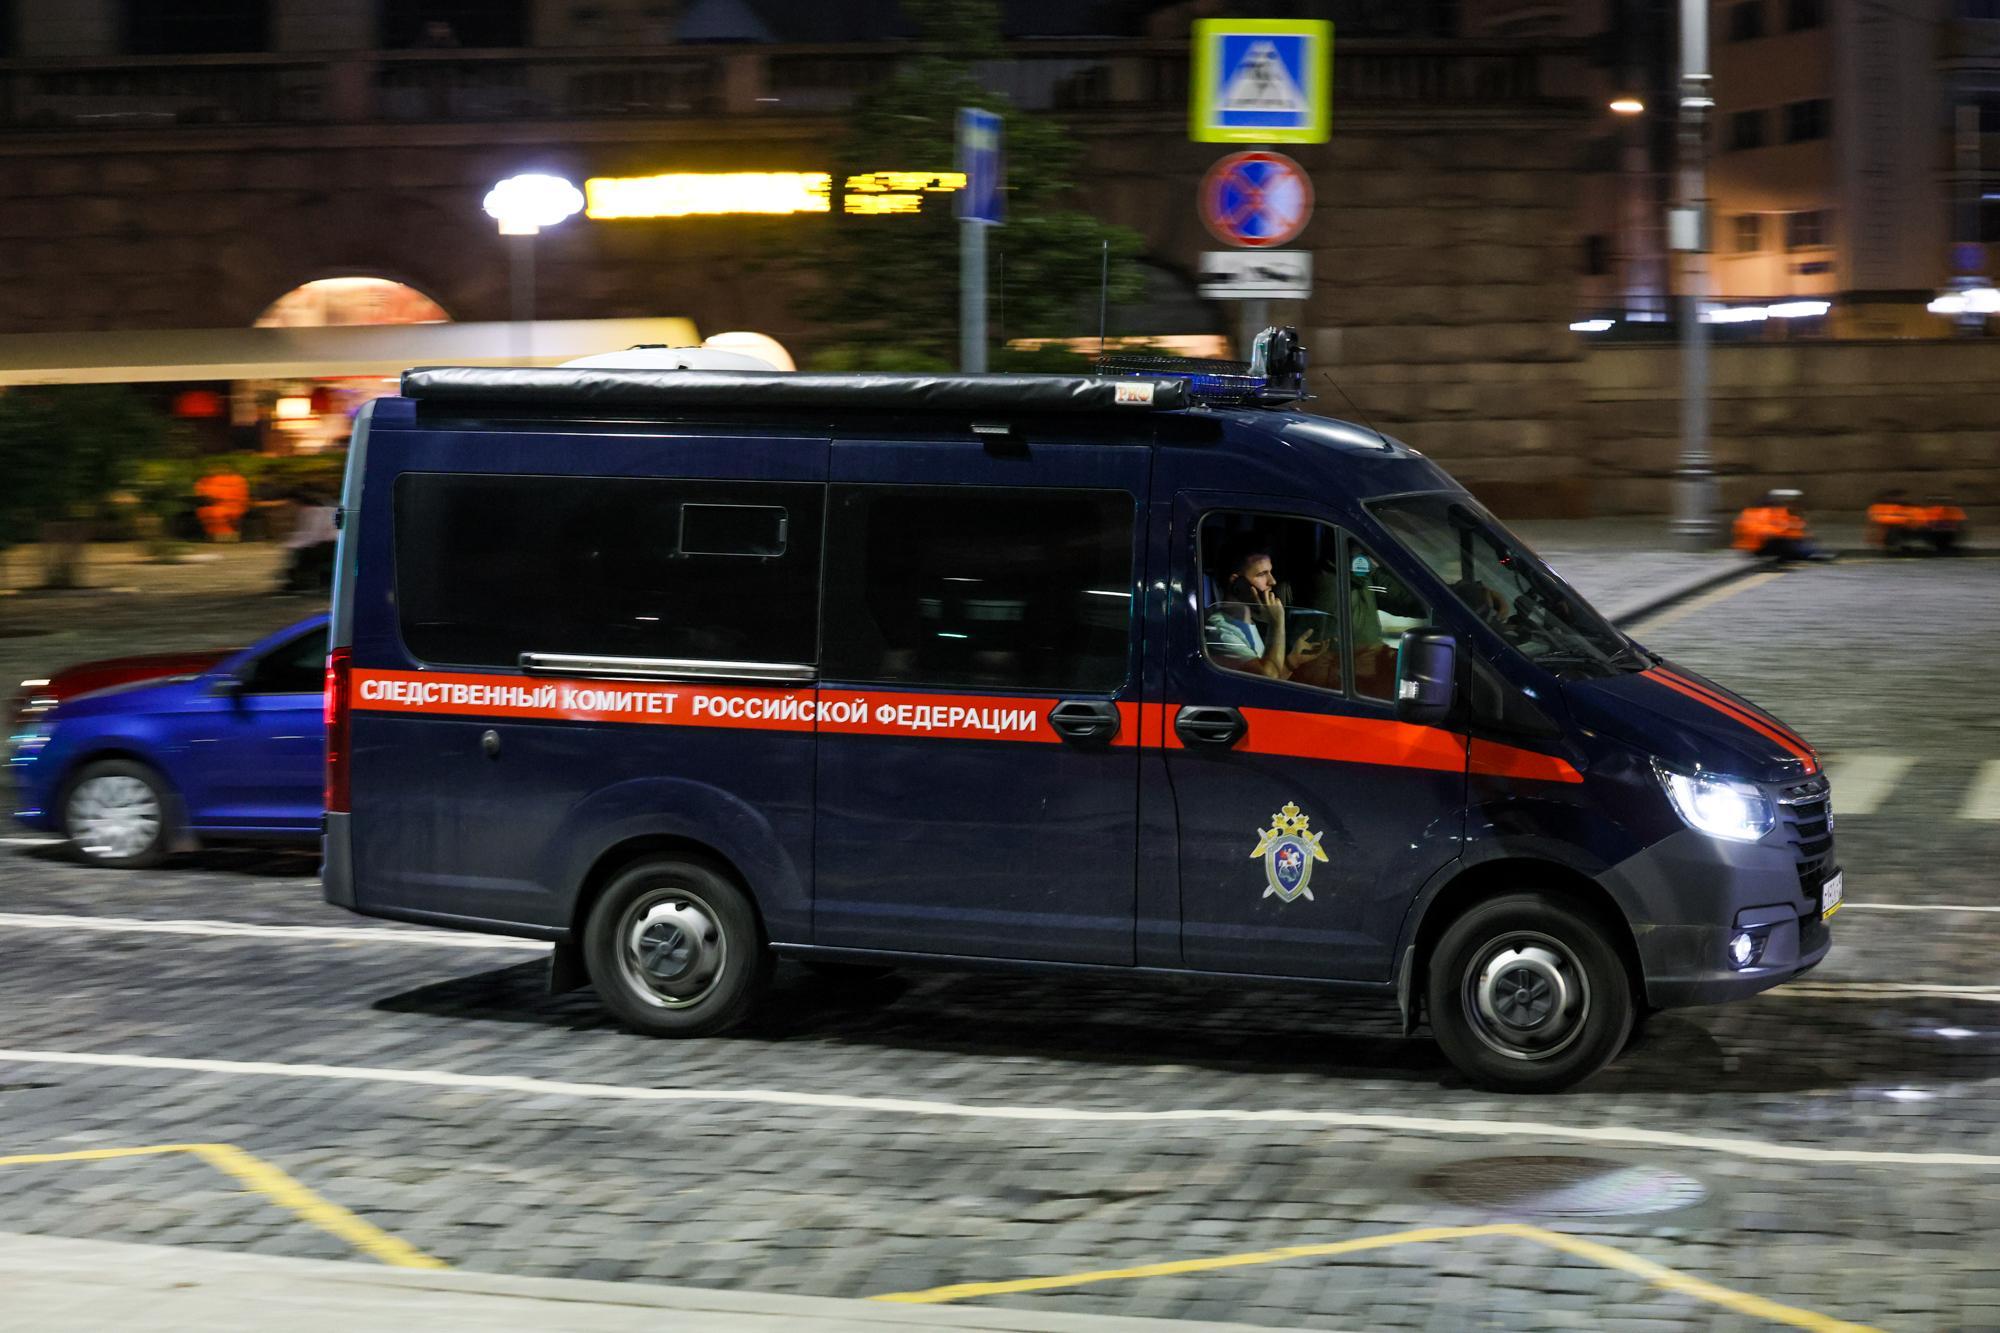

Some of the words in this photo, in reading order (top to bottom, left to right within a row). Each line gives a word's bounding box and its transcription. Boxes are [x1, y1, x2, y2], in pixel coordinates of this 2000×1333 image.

[360, 679, 556, 708] СЛЕДСТВЕННЫЙ
[562, 689, 678, 714] КОМИТЕТ
[692, 695, 868, 724] РОССИЙСКОЙ
[875, 703, 1037, 734] ФЕДЕРАЦИИ
